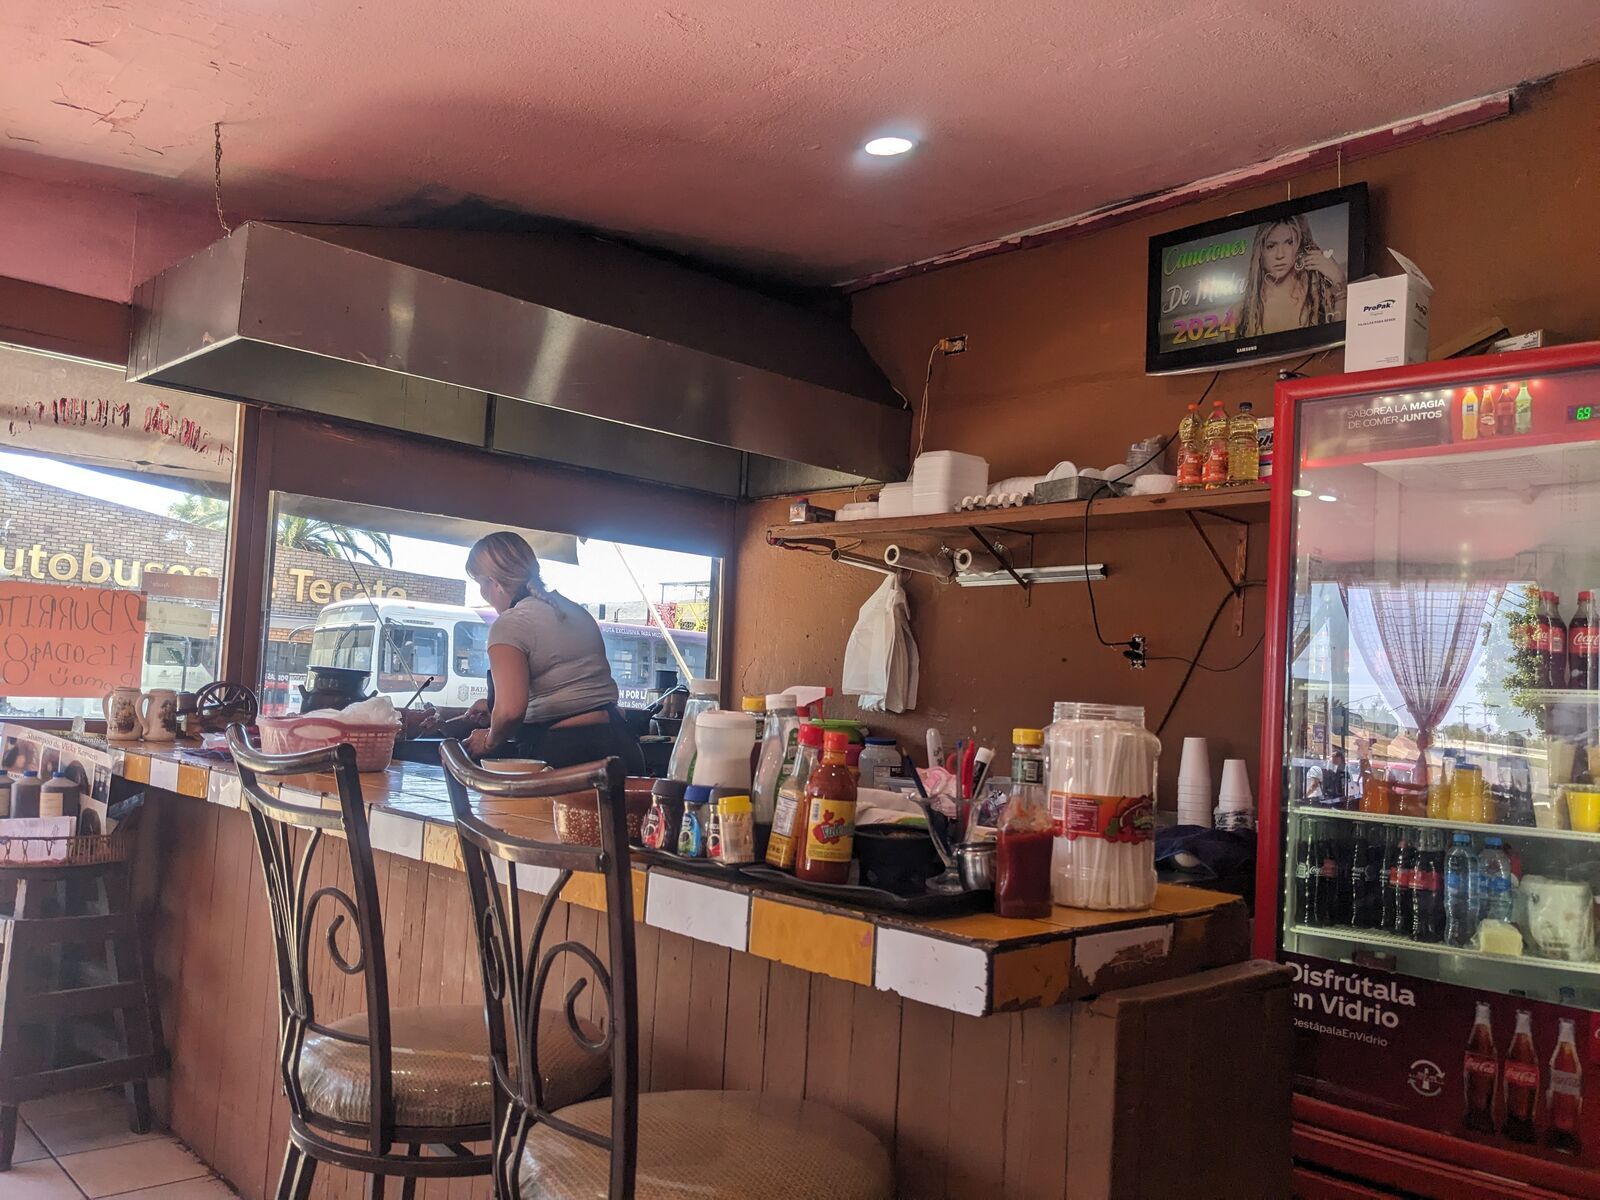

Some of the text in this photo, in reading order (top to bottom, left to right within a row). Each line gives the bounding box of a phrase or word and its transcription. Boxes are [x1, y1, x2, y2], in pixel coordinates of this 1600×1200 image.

[1163, 239, 1247, 276] Canciones
[1162, 284, 1191, 314] De
[1363, 303, 1391, 312] ProPak
[1172, 310, 1237, 345] 2024
[1236, 345, 1257, 353] SAMSUNG
[1347, 399, 1446, 420] SABOREA LA MAGIA
[1348, 410, 1443, 430] DE COMER JUNTOS
[626, 690, 639, 699] POR
[1285, 961, 1416, 1007] Disfrútala
[1319, 993, 1399, 1029] Vidrio
